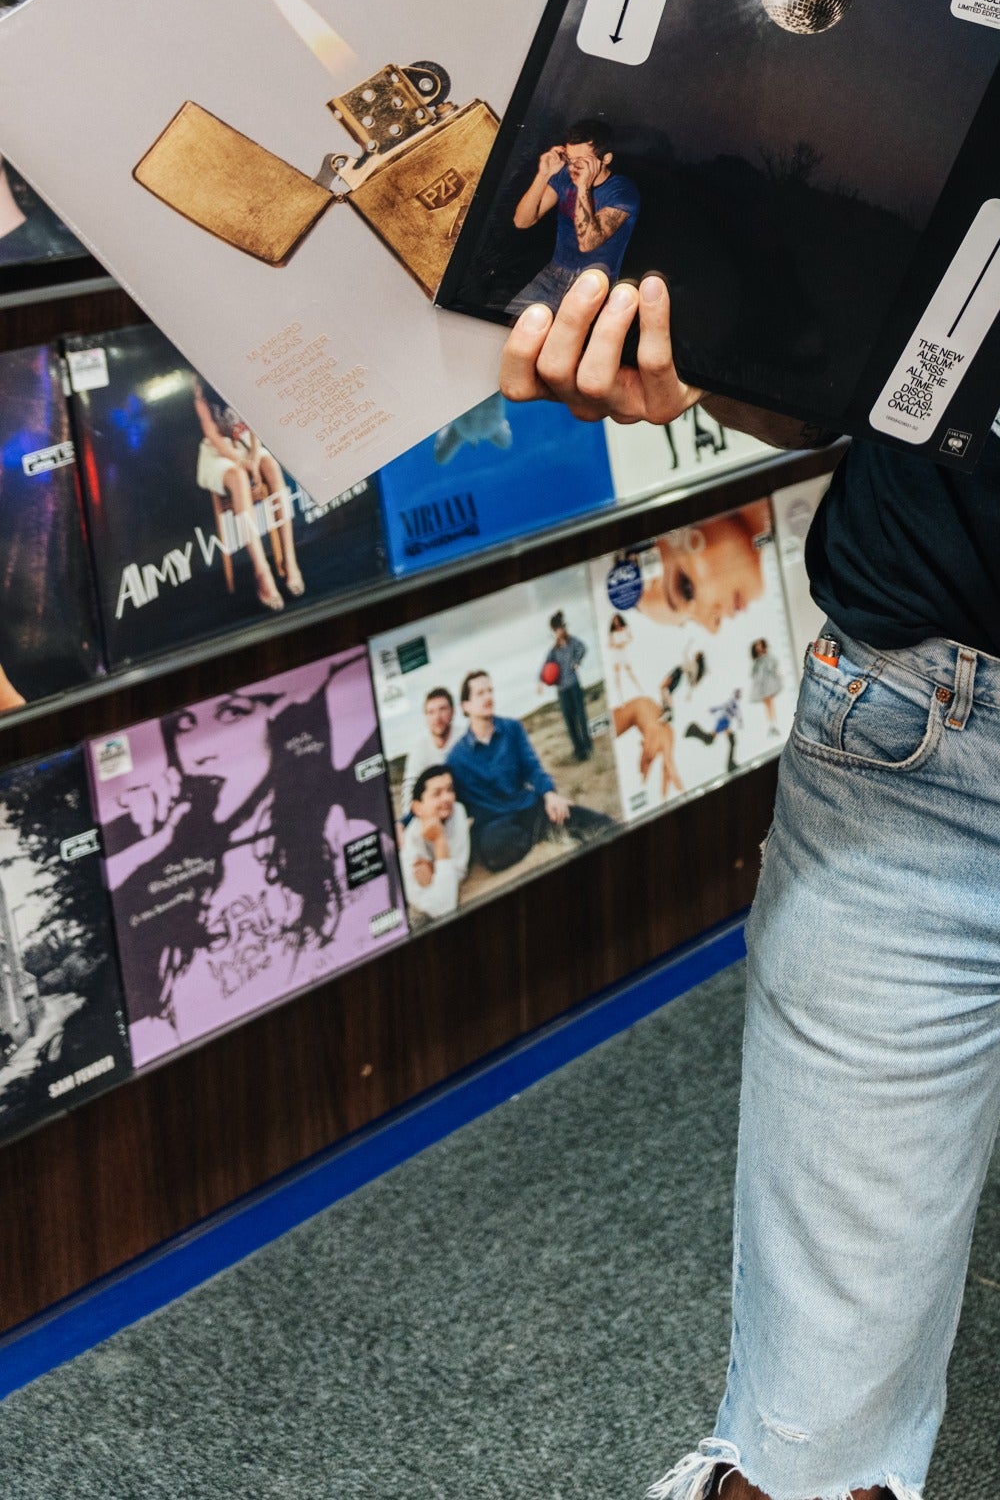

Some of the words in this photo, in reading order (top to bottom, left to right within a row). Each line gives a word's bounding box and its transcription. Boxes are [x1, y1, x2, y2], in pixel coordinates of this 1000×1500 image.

[957, 3, 982, 15] LIMITED
[422, 171, 458, 208] PZF
[246, 321, 303, 363] MUMFORD
[255, 333, 332, 387] PRIZEFIGHTER
[271, 335, 303, 360] SONS
[917, 350, 955, 370] ALBUM:
[918, 338, 940, 354] THE
[938, 347, 965, 363] NEW
[277, 356, 339, 399] FEATURING
[906, 365, 924, 380] ALL
[927, 372, 948, 388] THE
[279, 396, 320, 426] GRACIE
[296, 410, 320, 428] GIGI
[319, 385, 355, 411] PEREZ
[321, 400, 356, 425] CHRIS
[893, 390, 933, 412] OCCASI-
[315, 398, 377, 442] STAPLETON
[399, 491, 478, 539] NIRVANA
[115, 541, 193, 621] AMY
[194, 481, 316, 568] WINEH
[48, 1074, 75, 1099] SAM
[74, 1054, 115, 1087] FENDER
